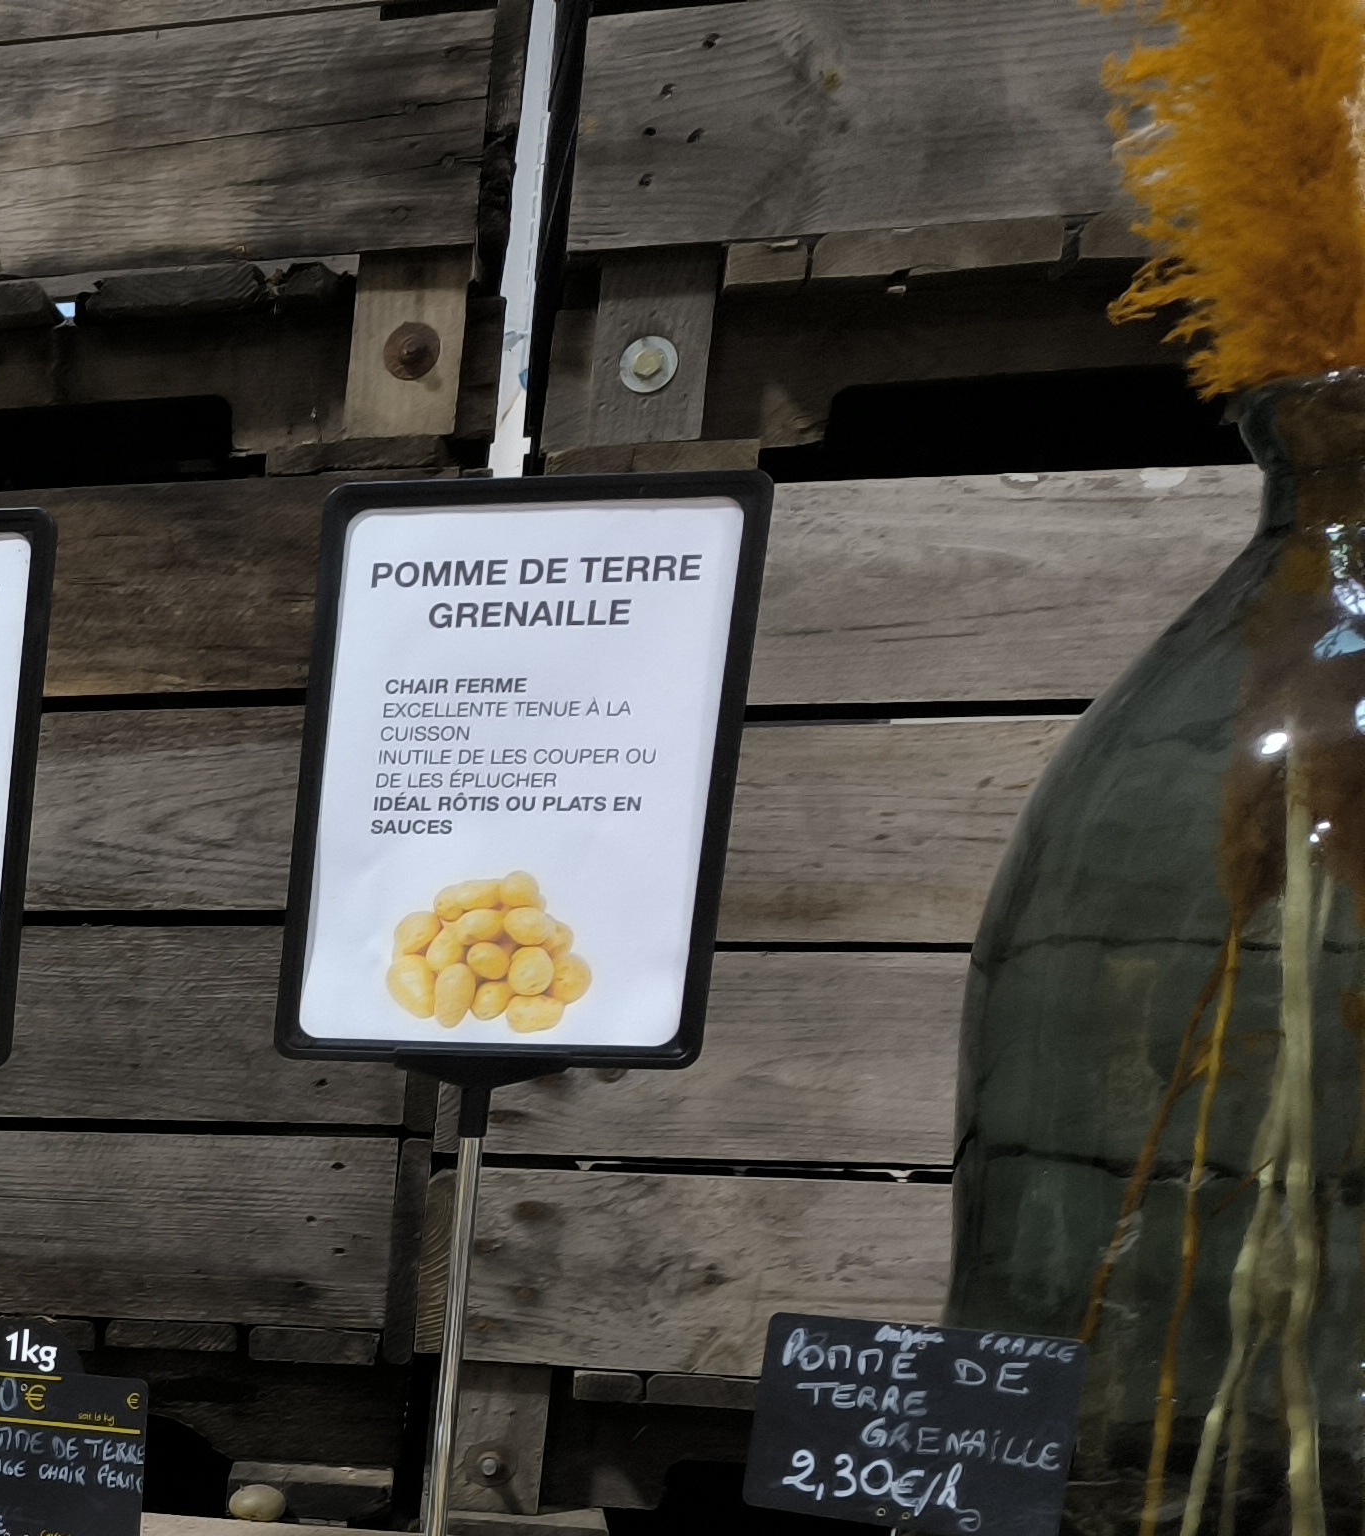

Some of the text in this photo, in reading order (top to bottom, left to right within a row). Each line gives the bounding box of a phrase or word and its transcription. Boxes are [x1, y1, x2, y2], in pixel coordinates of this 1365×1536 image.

[372, 555, 702, 588] POMME DE TERRE
[429, 600, 631, 628] GRENAILLE
[386, 678, 527, 694] CHAIR FERME
[383, 698, 630, 718] EXCELLENTE TENUE À LA
[381, 726, 470, 741] CUISSON
[379, 749, 656, 765] INUTILE DE LES COUPER OU
[376, 769, 556, 788] DE LES ÉPLUCHER
[374, 792, 641, 811] IDÉAL RÔTIS OU PLATS EN
[371, 820, 452, 834] SAUCES
[5, 1329, 57, 1371] 1kg
[979, 1332, 1077, 1362] FRANCE
[954, 1359, 1030, 1395] DE
[127, 1392, 140, 1410] €
[796, 1382, 928, 1416] TERRE
[103, 1414, 115, 1426] kg
[52, 1436, 79, 1459] DE
